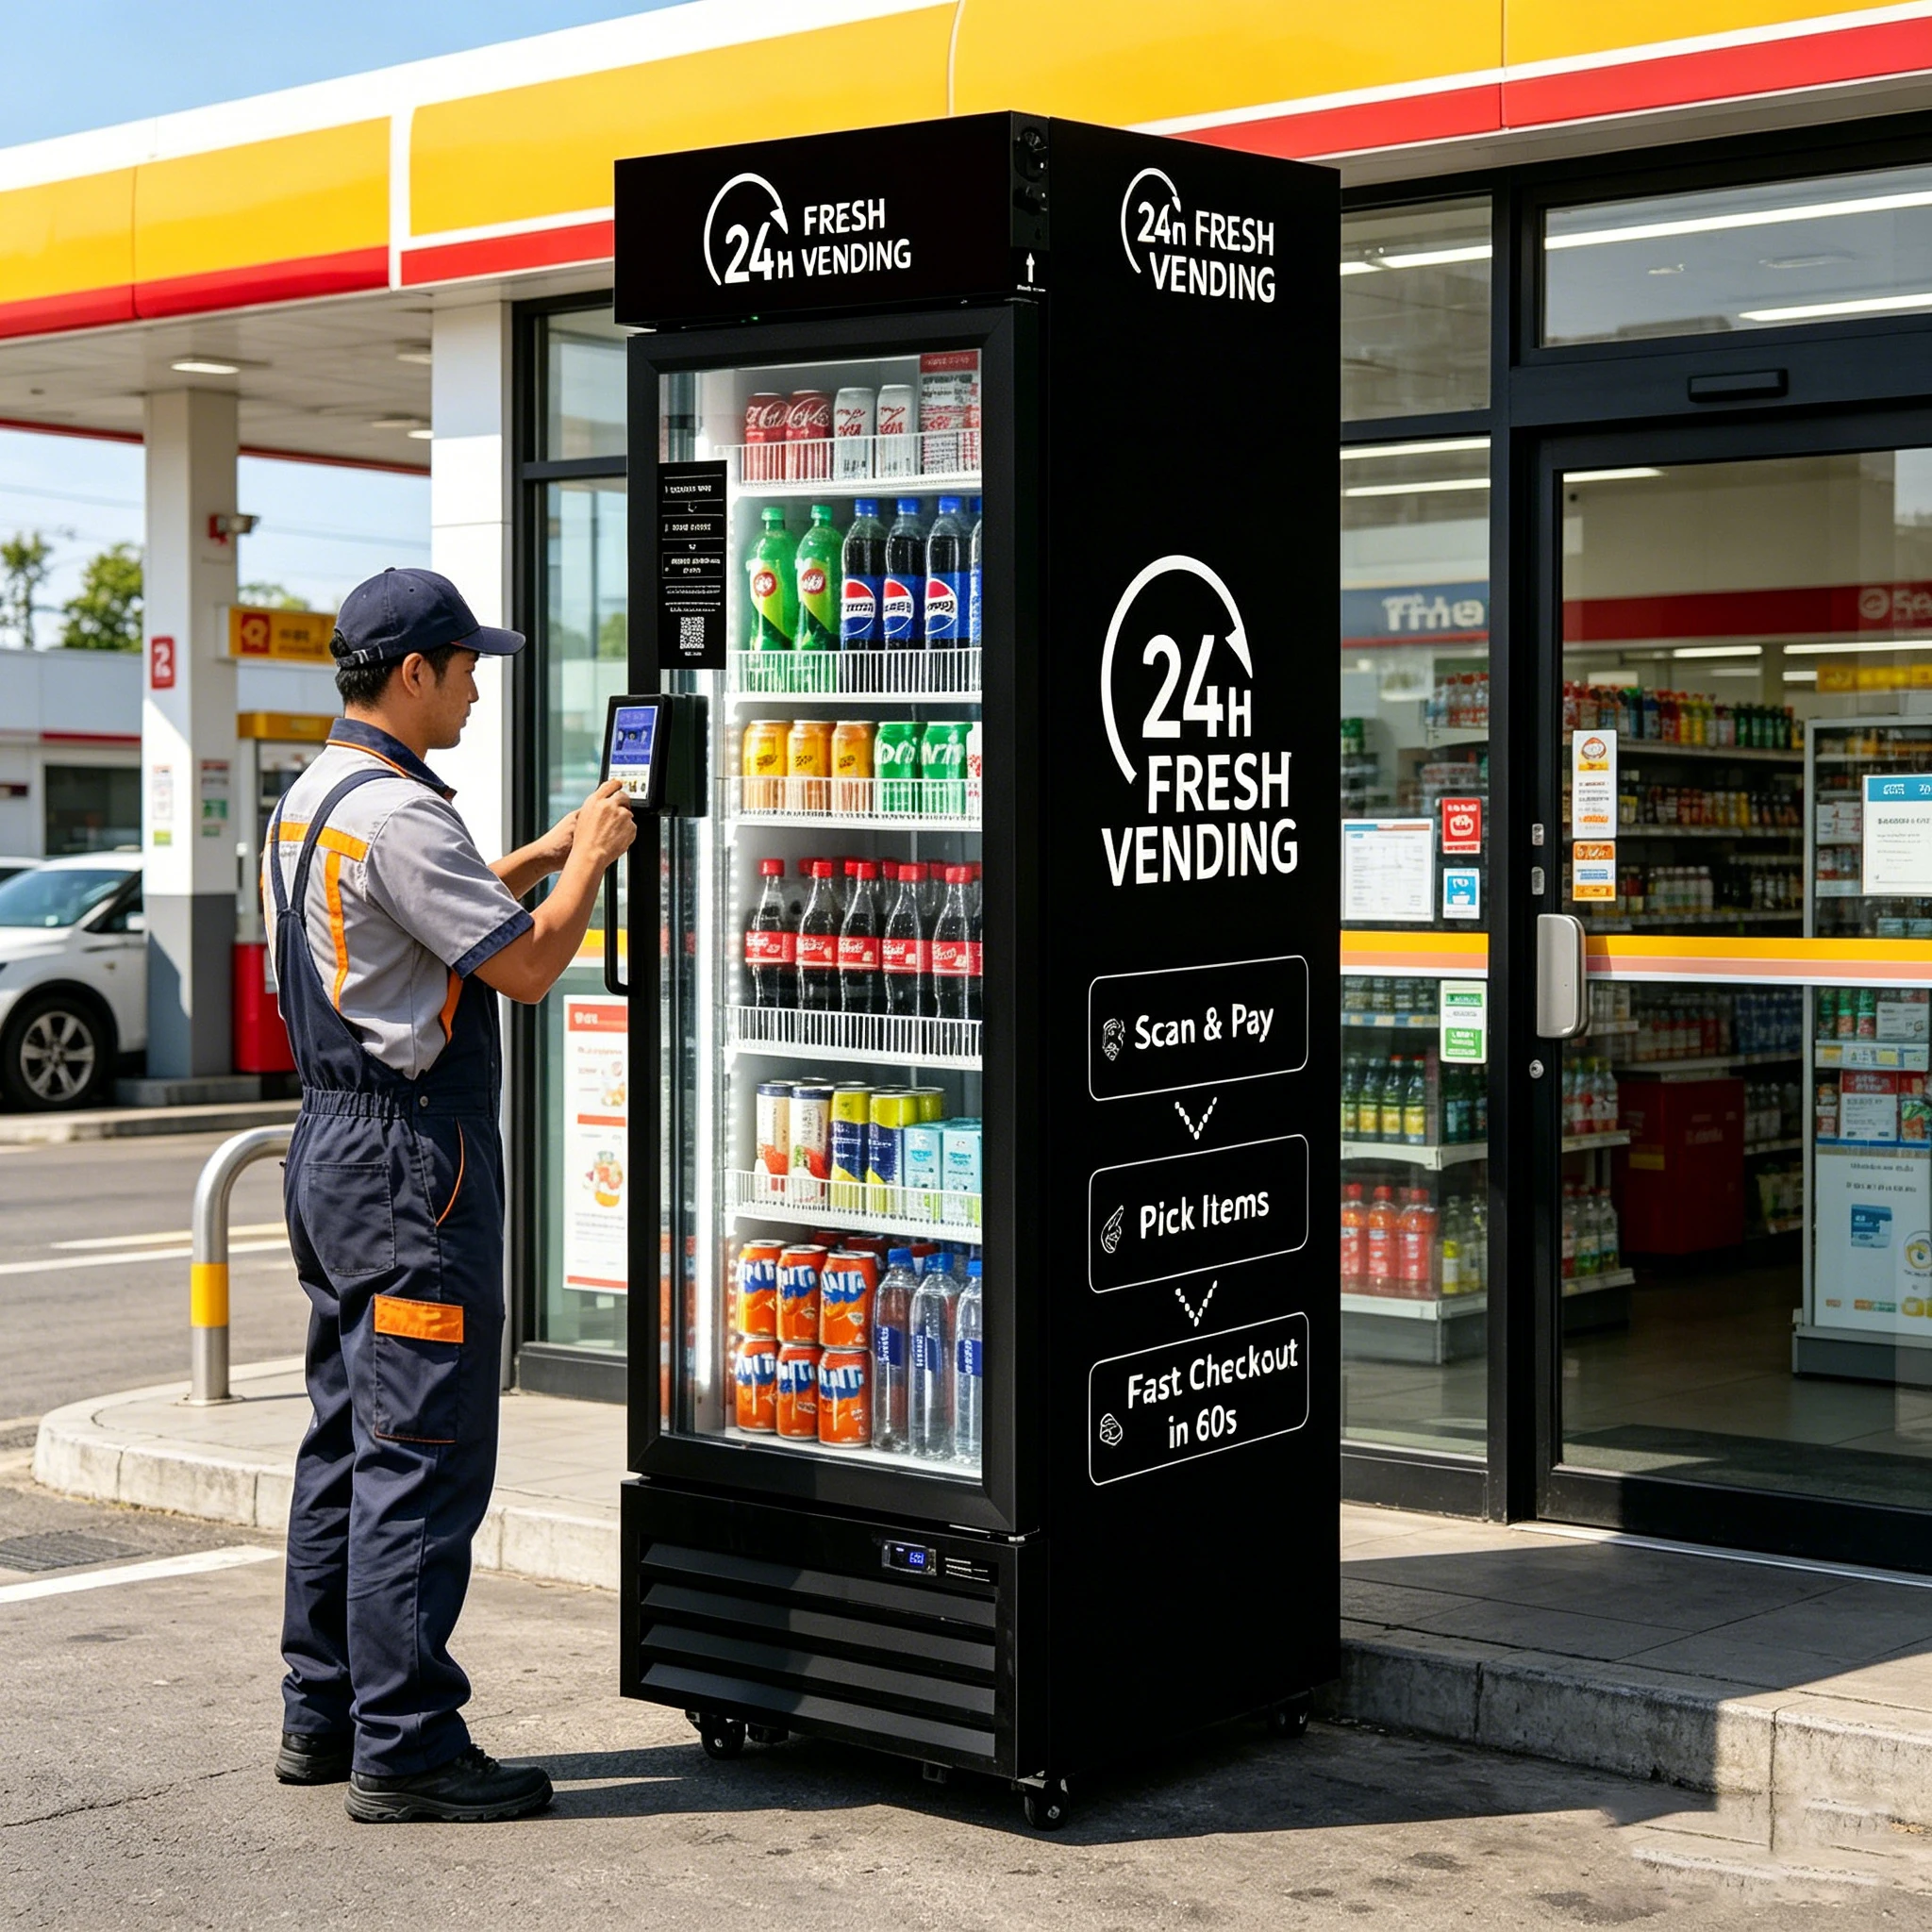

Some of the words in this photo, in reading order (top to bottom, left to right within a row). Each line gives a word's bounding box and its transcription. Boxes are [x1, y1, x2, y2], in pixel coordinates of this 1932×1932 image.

[804, 197, 886, 236] FRESH
[1195, 209, 1274, 257] FRESH
[724, 221, 794, 284] 24H
[802, 238, 911, 277] VENDING
[1149, 251, 1275, 304] VENDING
[1141, 634, 1252, 739] 24H
[1147, 751, 1292, 814] FRESH
[1101, 818, 1298, 887] VENDING
[1134, 1014, 1196, 1050] Scan
[1203, 1007, 1223, 1041] &
[1231, 1003, 1274, 1043] Pay
[1140, 1196, 1195, 1240] Pick
[1203, 1191, 1270, 1228] Items
[1127, 1366, 1183, 1409] Fast
[1189, 1338, 1299, 1391] Checkout
[1168, 1415, 1189, 1449] in
[1195, 1405, 1238, 1441] 60s
